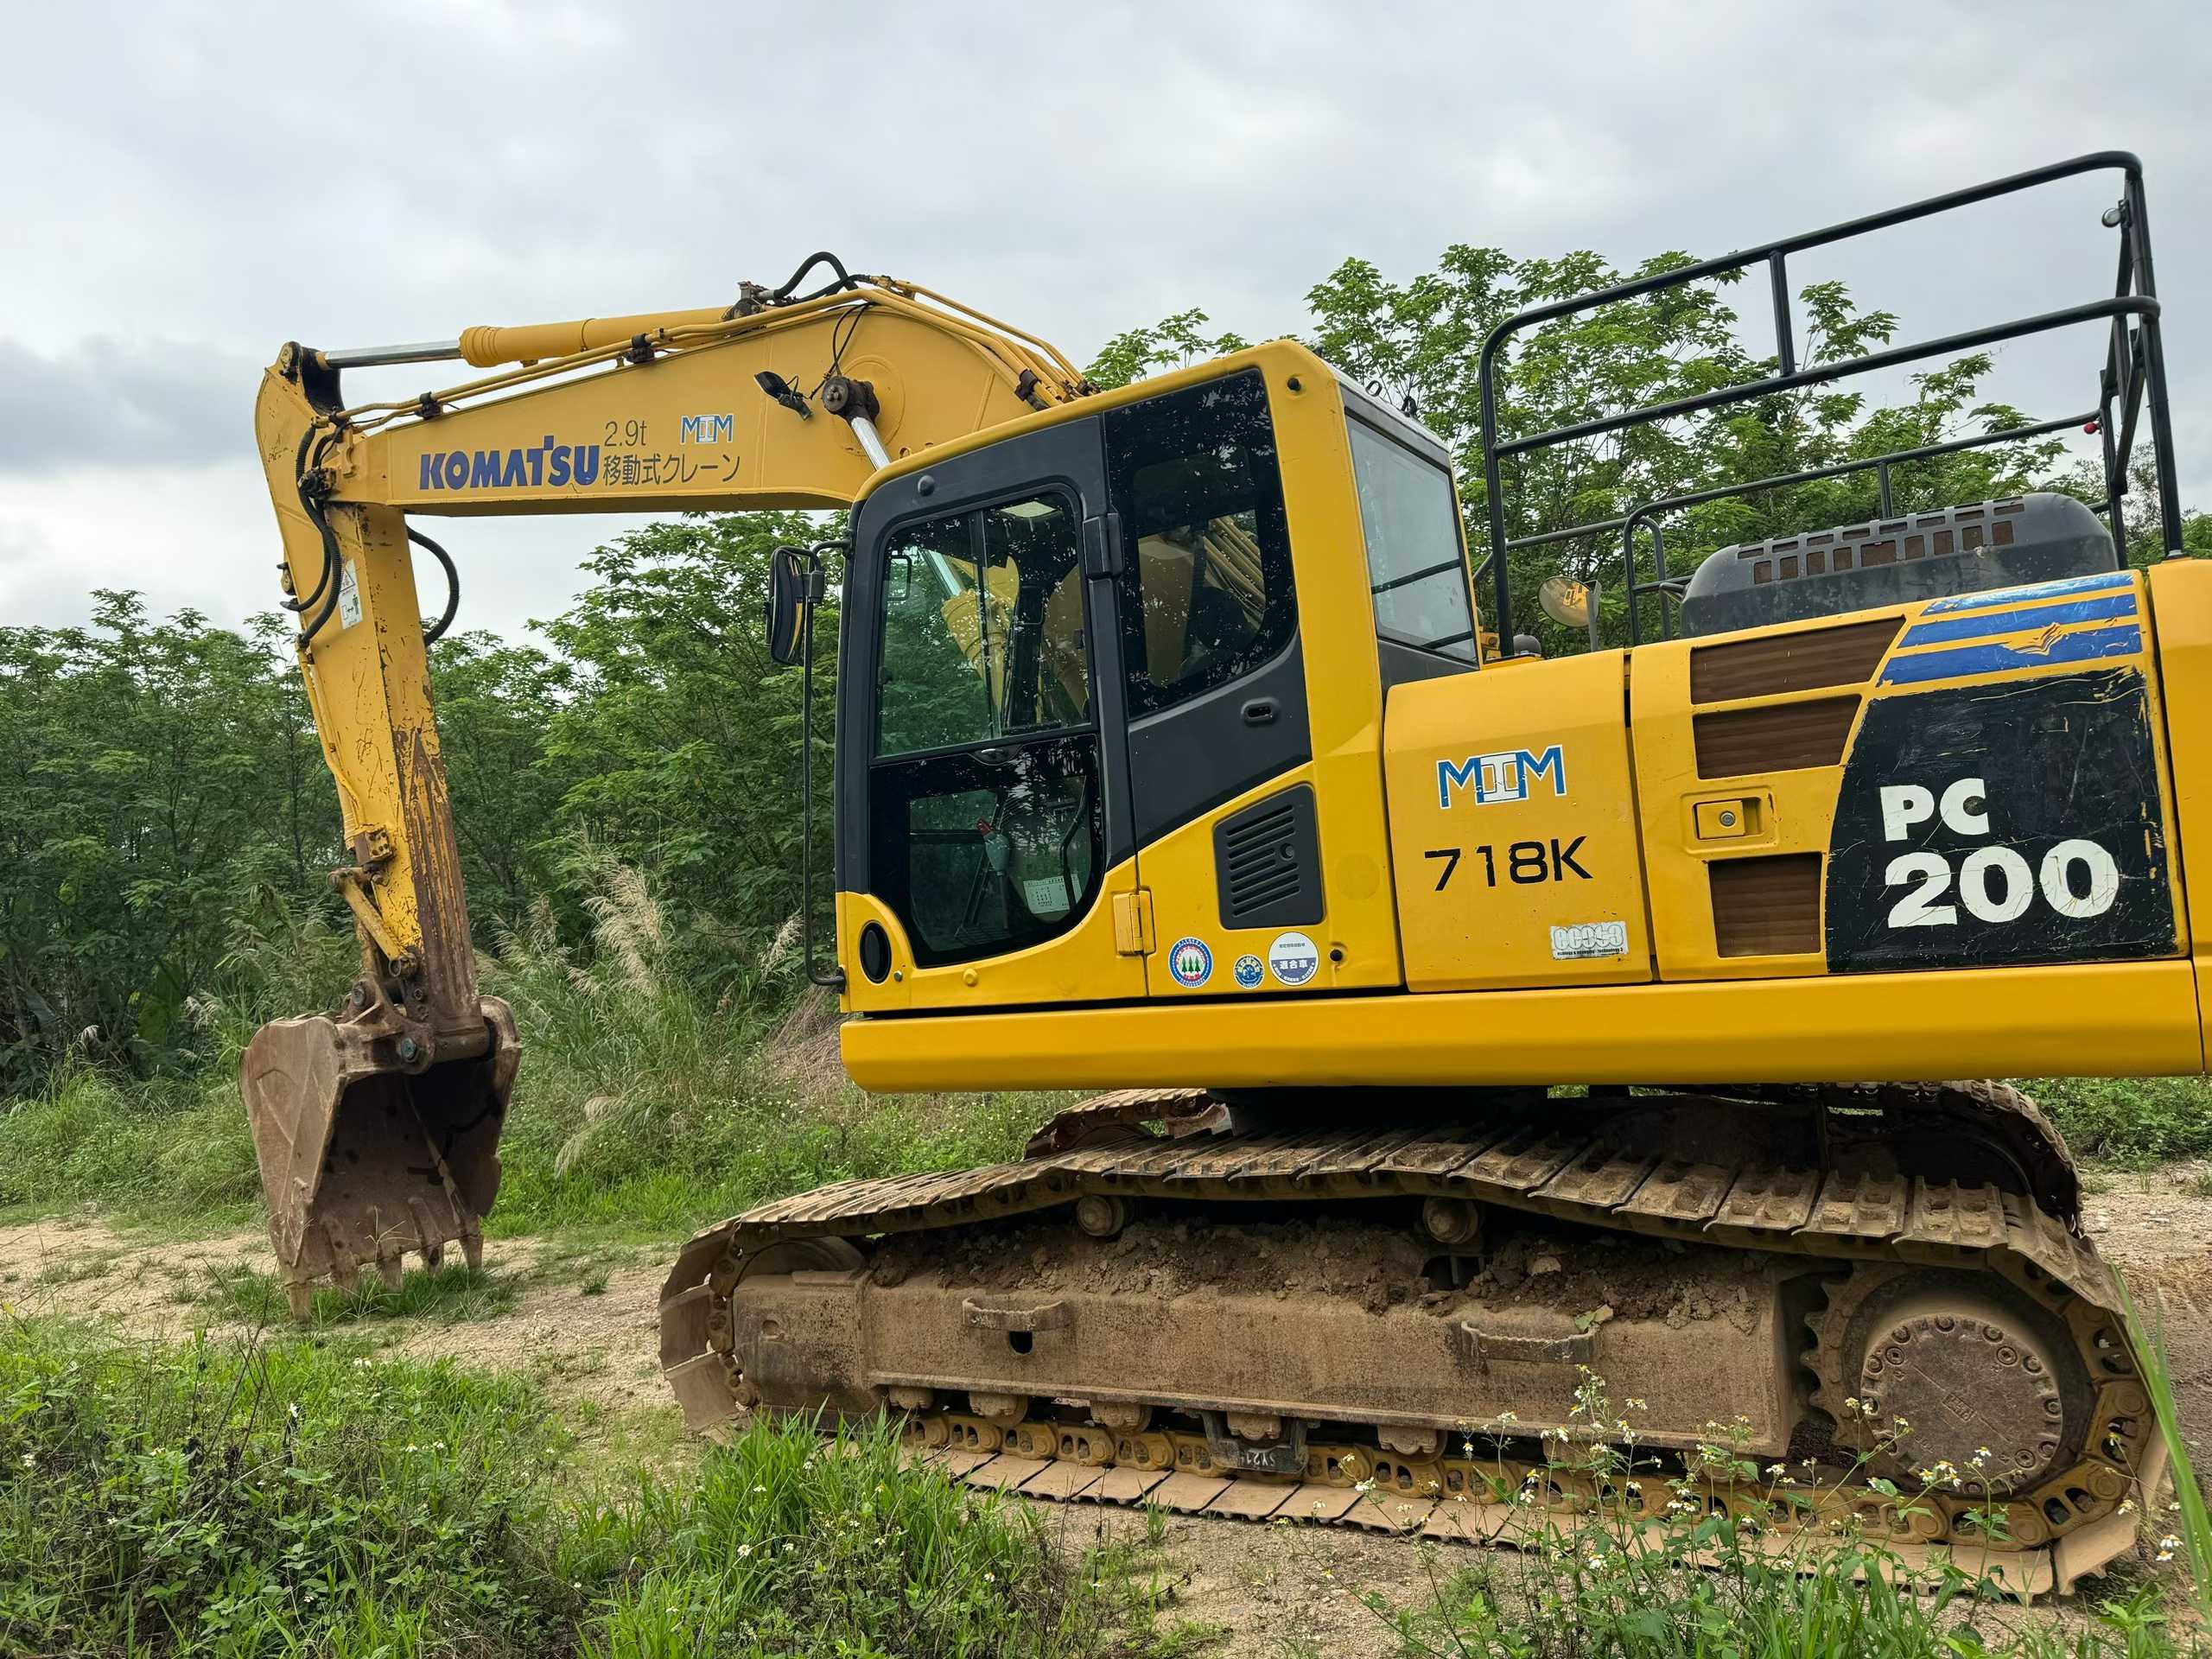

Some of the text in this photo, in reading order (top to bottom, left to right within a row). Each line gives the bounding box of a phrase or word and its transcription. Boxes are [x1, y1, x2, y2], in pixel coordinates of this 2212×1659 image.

[604, 420, 647, 448] 2.9t
[419, 435, 600, 491] KOMATSU
[603, 453, 741, 486] 移動式クレーン
[1879, 778, 1989, 842] PC
[1424, 836, 1593, 891] 718K
[1885, 839, 2120, 929] 200
